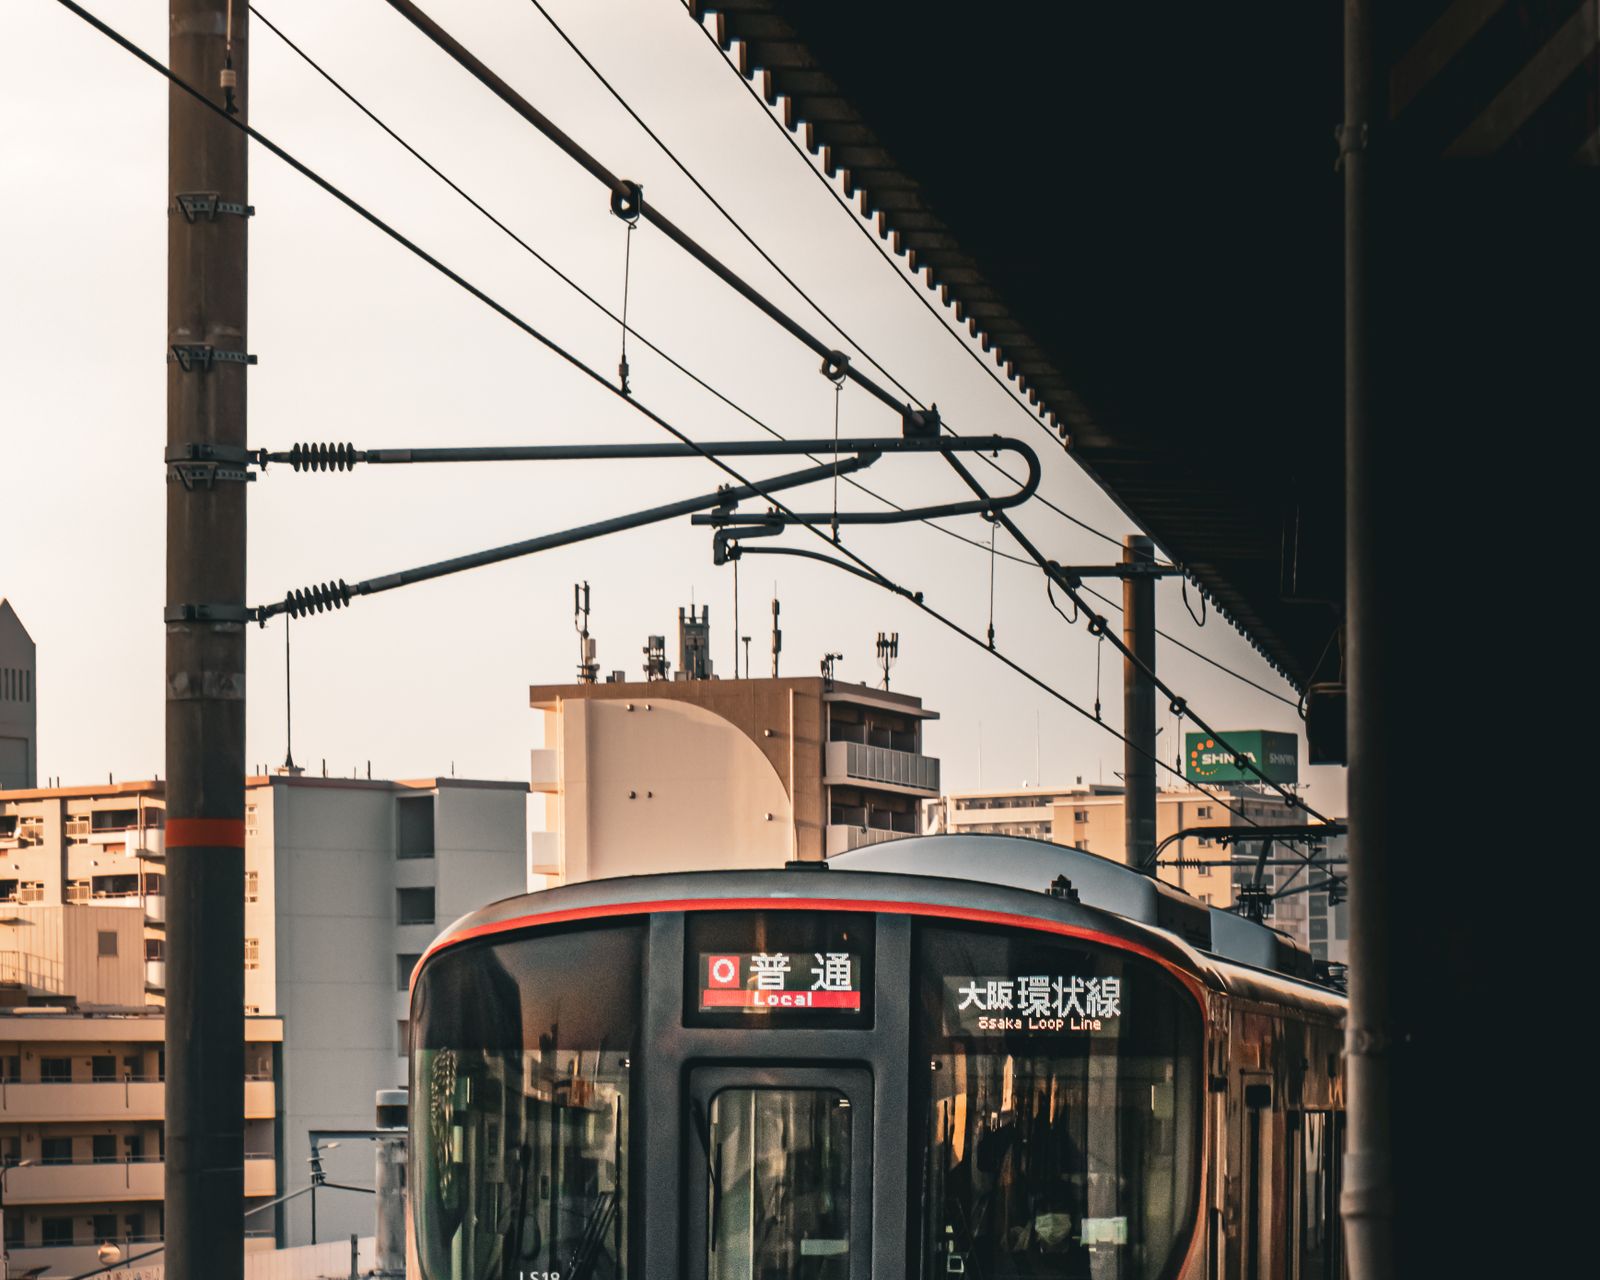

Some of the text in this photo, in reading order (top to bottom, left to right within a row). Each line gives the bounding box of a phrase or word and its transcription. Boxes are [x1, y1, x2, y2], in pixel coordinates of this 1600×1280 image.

[750, 952, 852, 991] 普通
[753, 991, 812, 1006] Local
[958, 976, 1121, 1018] 大阪環状線
[1028, 1018, 1064, 1031] Loop
[1071, 1017, 1102, 1030] Line
